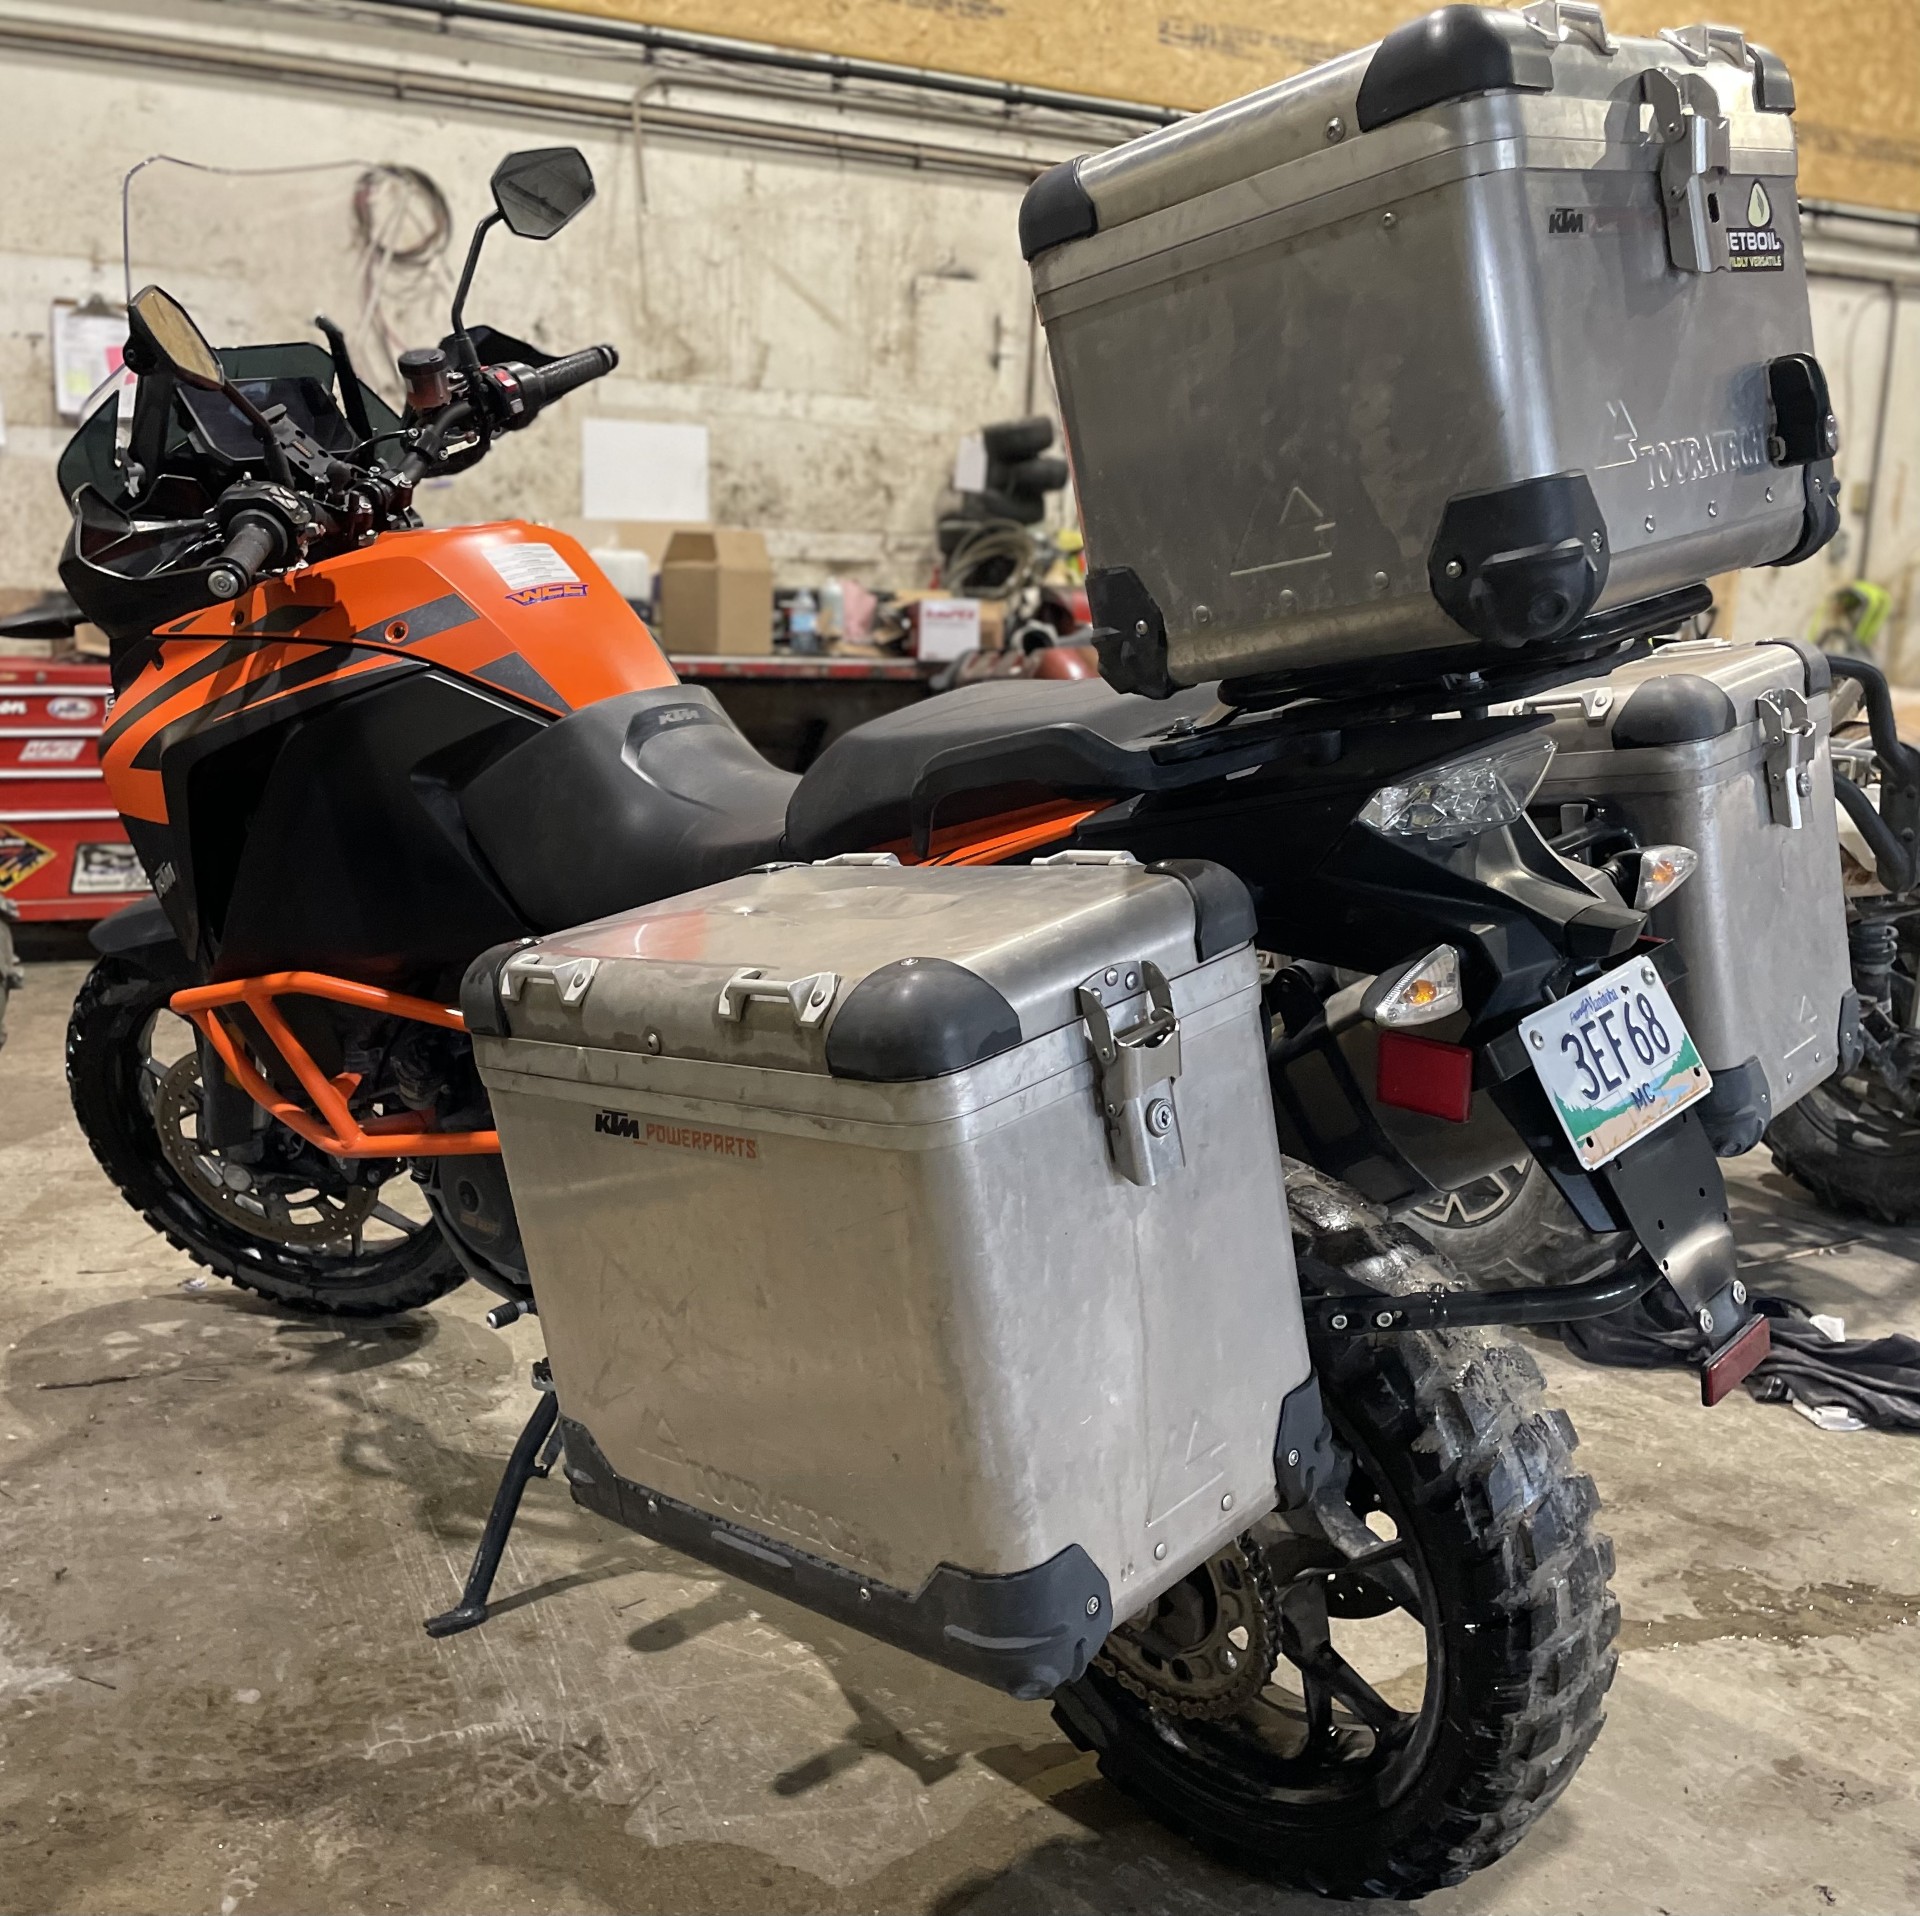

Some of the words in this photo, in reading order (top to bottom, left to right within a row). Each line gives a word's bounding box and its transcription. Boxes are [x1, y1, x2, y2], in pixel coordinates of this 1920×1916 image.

[1549, 208, 1583, 233] KTM
[1727, 232, 1780, 250] ETBOIL
[1749, 255, 1782, 267] VERSATILE
[658, 708, 700, 725] KTM
[1630, 1082, 1656, 1111] MC
[595, 1109, 640, 1139] KTM
[646, 1123, 757, 1159] POWERPARTS
